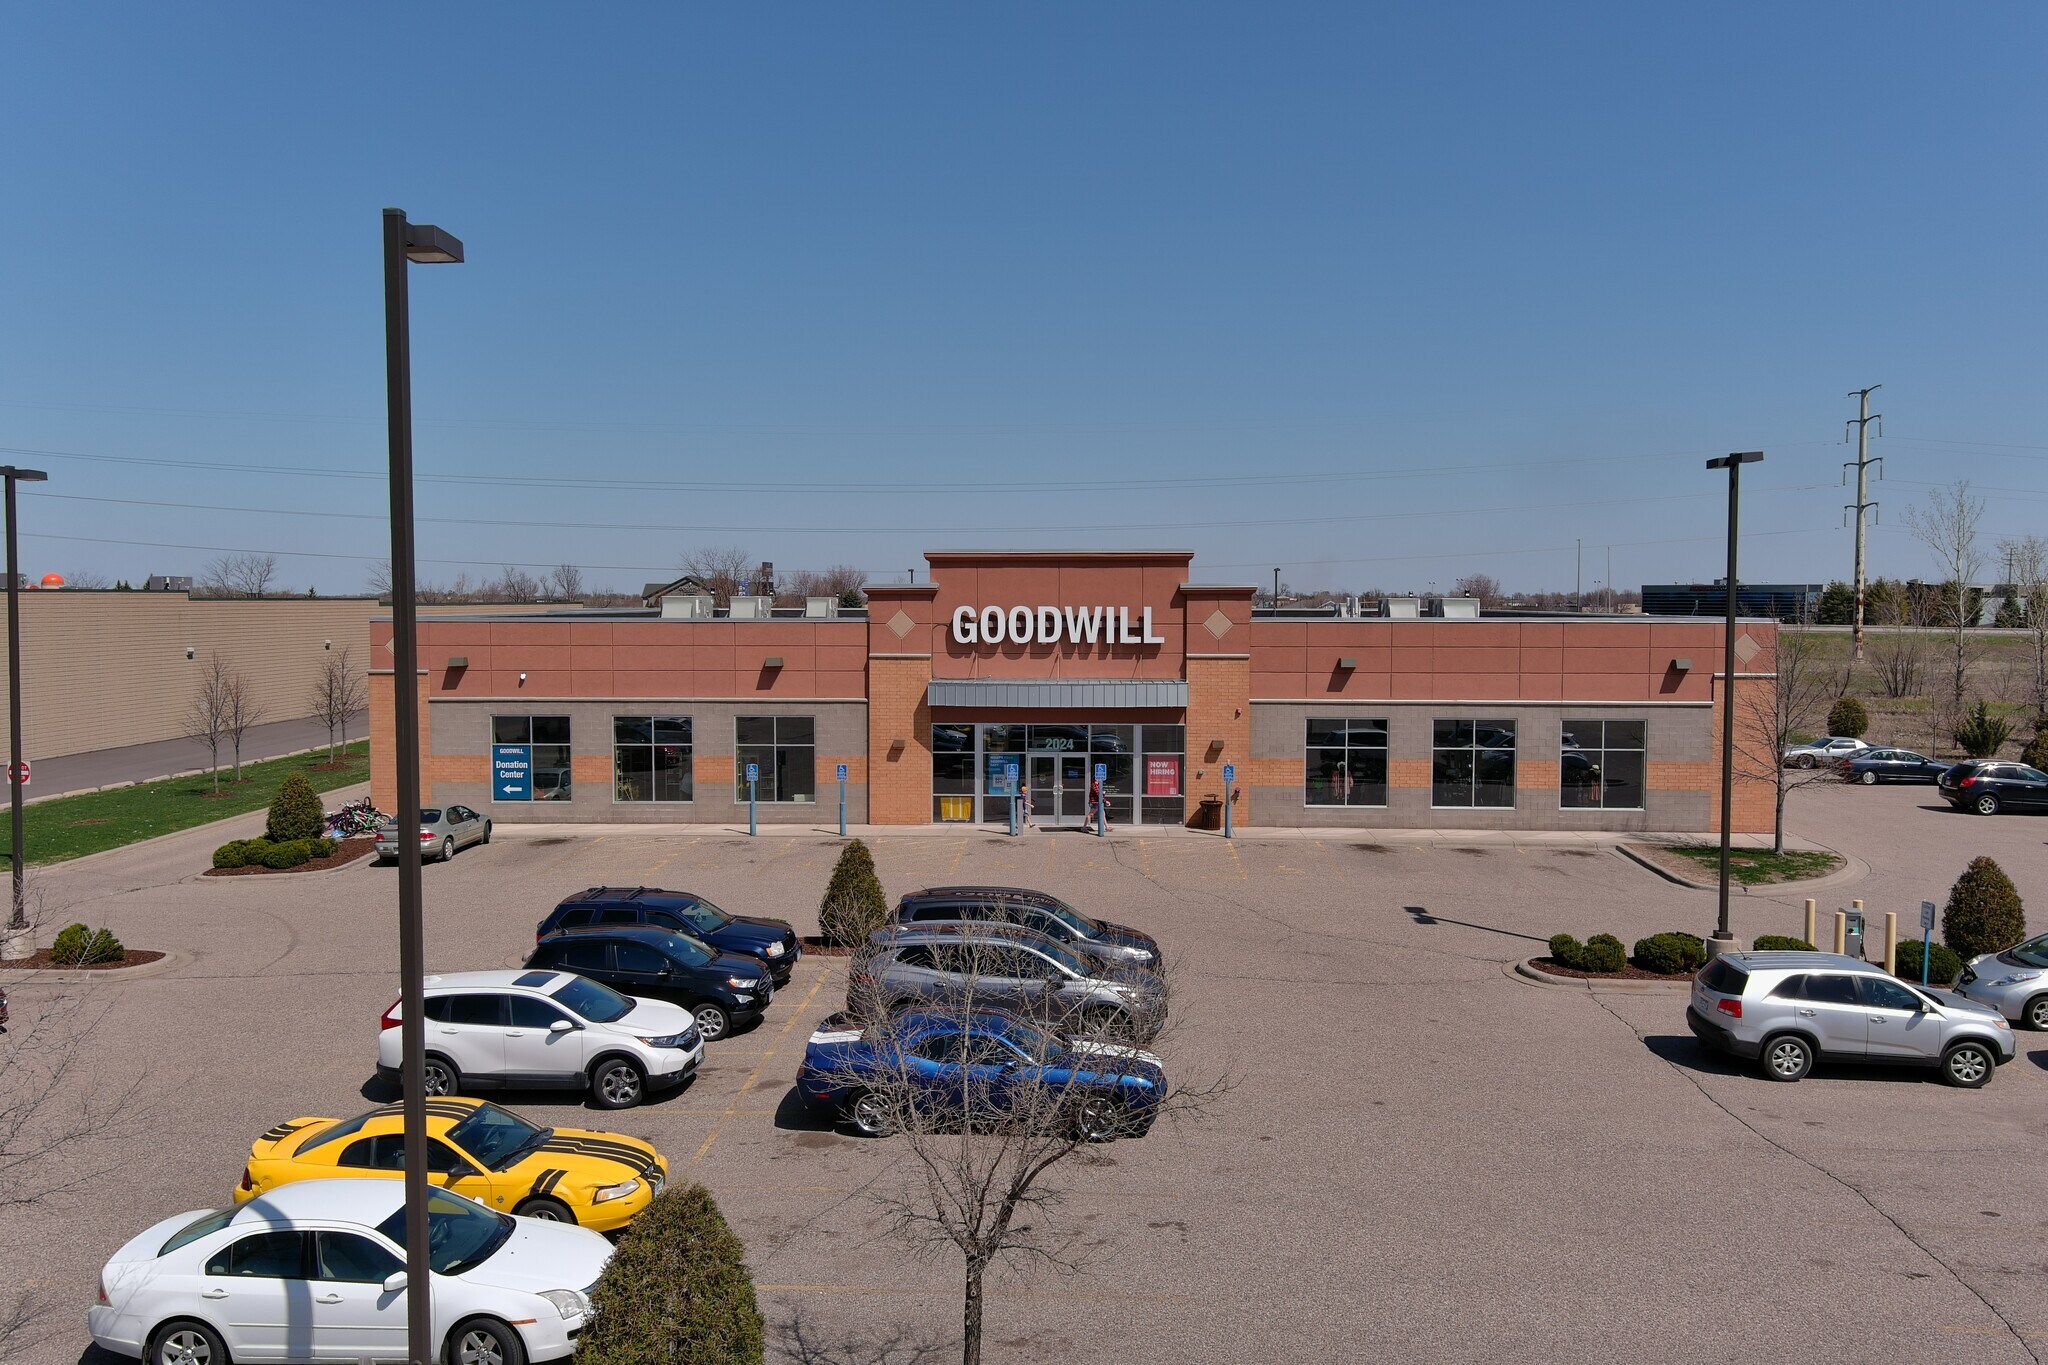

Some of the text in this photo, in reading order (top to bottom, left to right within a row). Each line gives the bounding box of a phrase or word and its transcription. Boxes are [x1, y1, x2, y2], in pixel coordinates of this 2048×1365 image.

[952, 605, 1165, 644] GOODWILL
[1045, 738, 1075, 750] 2024
[495, 760, 528, 769] Donation
[500, 770, 524, 779] Center
[1150, 768, 1175, 776] HIRING
